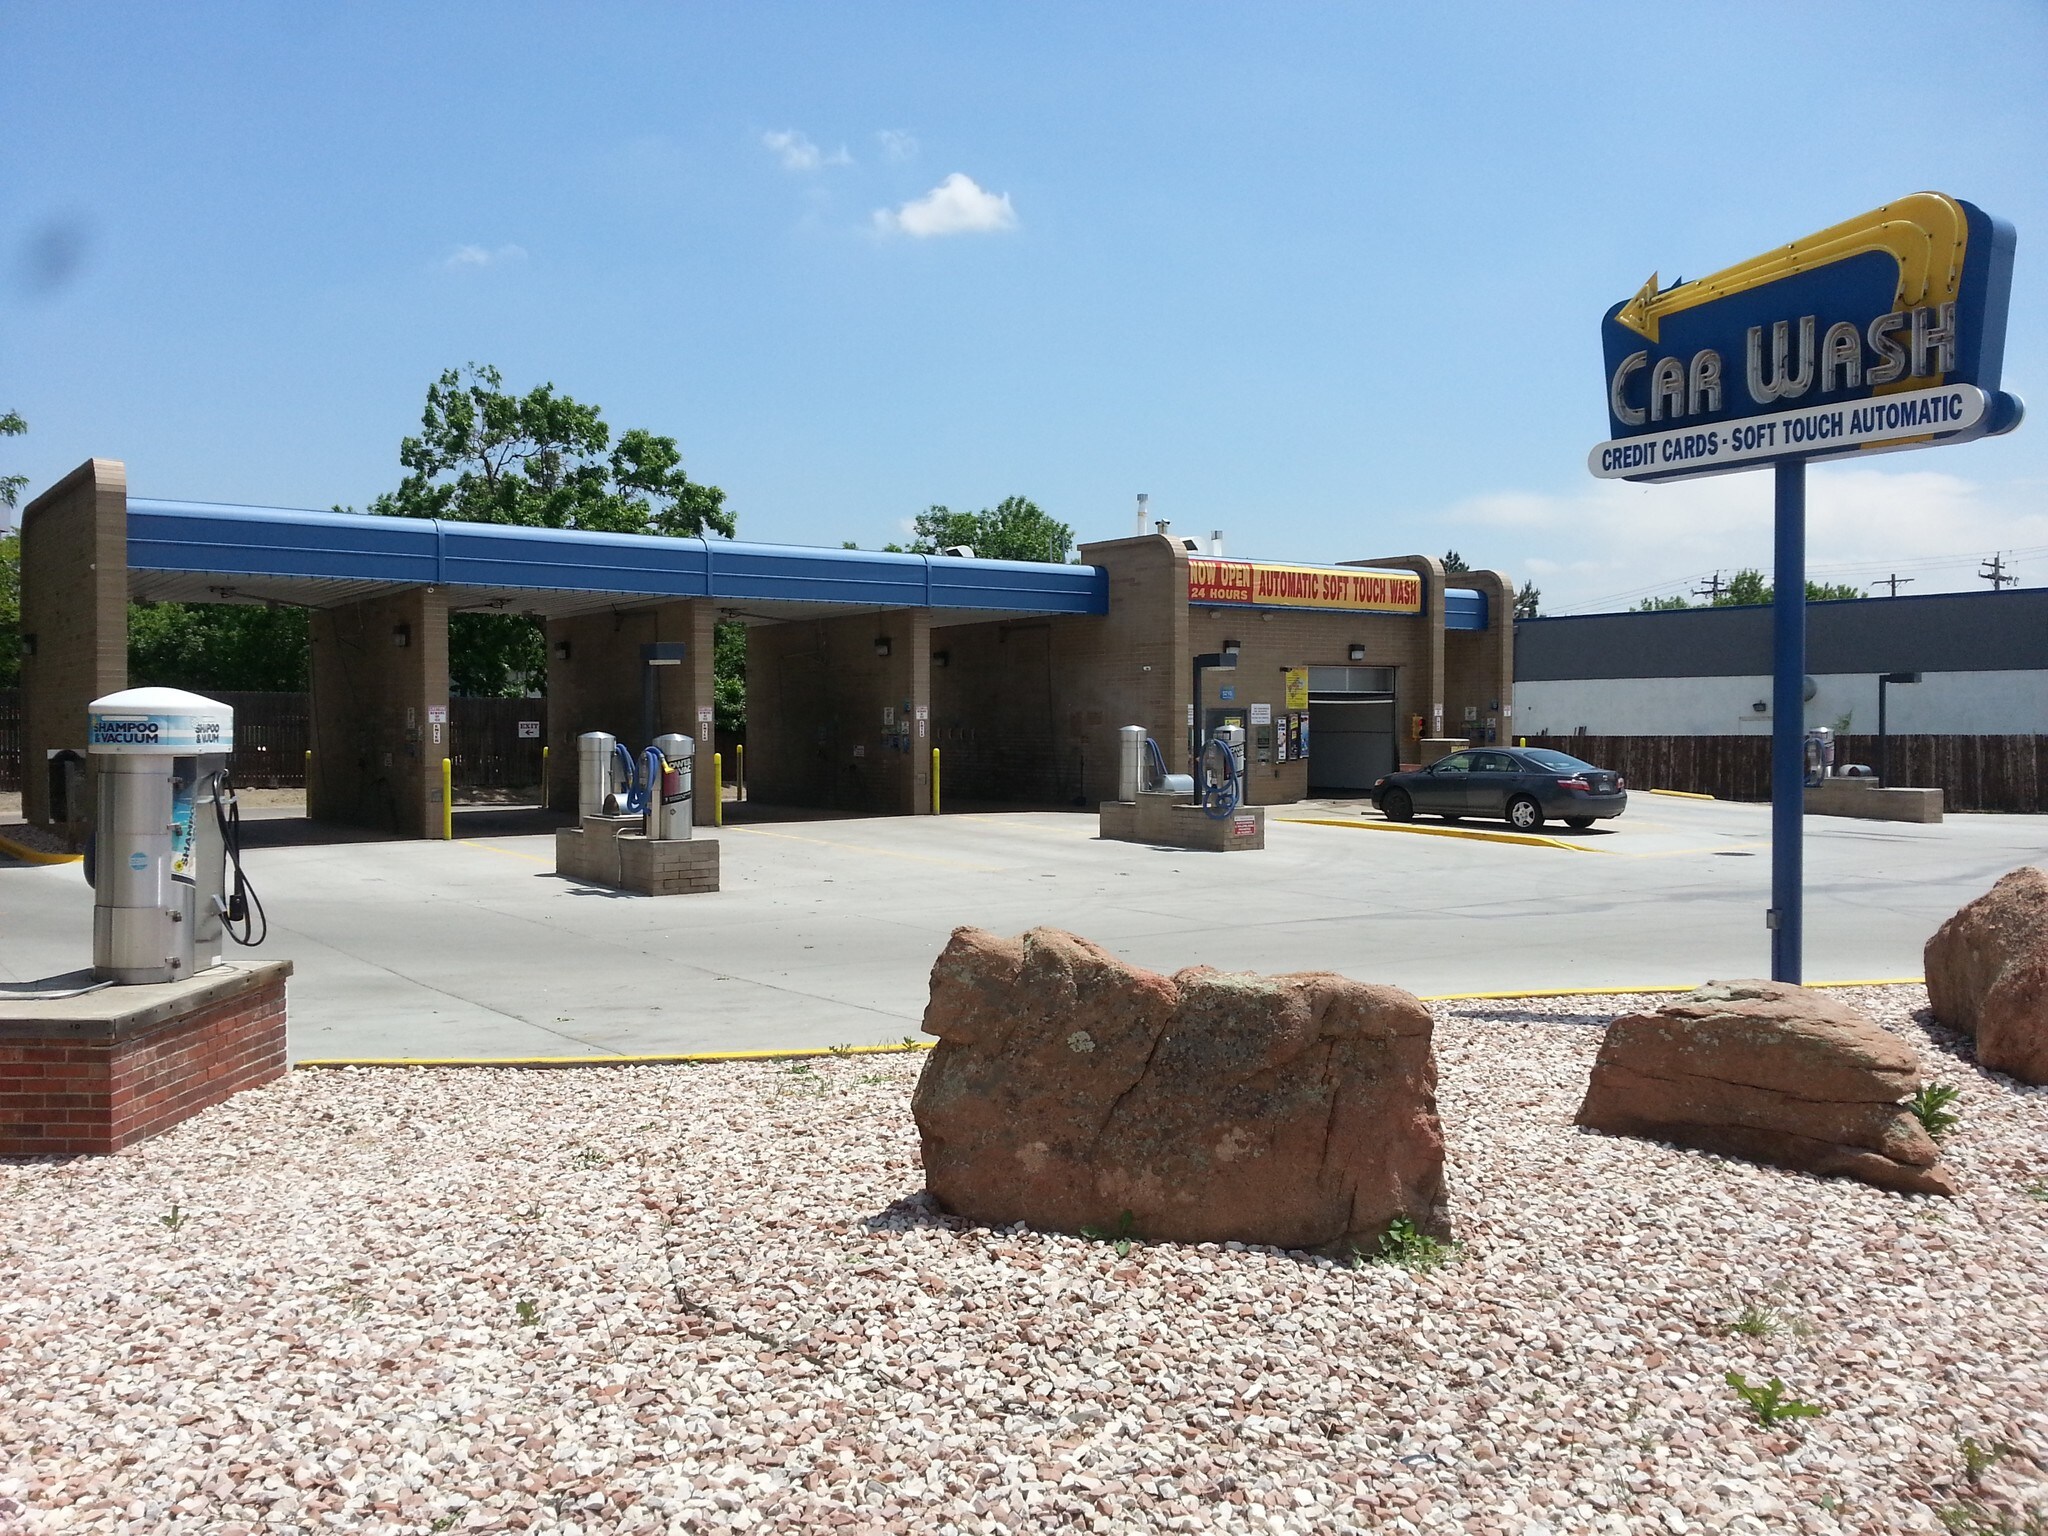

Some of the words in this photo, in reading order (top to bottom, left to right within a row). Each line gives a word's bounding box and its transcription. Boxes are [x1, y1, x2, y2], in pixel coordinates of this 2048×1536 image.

[1611, 349, 1723, 427] CAR
[1746, 301, 1957, 405] WASH
[1602, 441, 1657, 472] CREDIT
[1662, 431, 1719, 463] CARDS
[1731, 422, 1776, 452] SOFT
[1782, 411, 1844, 442] TOUCH
[1849, 393, 1963, 434] AUTOMATIC
[1188, 561, 1216, 585] NOW
[1221, 563, 1250, 587] OPEN
[1191, 587, 1206, 599] 24
[1210, 588, 1248, 600] HOURS
[1258, 570, 1318, 599] AUTOMATIC
[1323, 574, 1349, 601] SOFT
[1353, 576, 1386, 604] TOUCH
[1389, 578, 1418, 605] WASH
[93, 722, 158, 733] SHAMPOO
[101, 733, 158, 743] VACUUM
[667, 758, 692, 769] OWER
